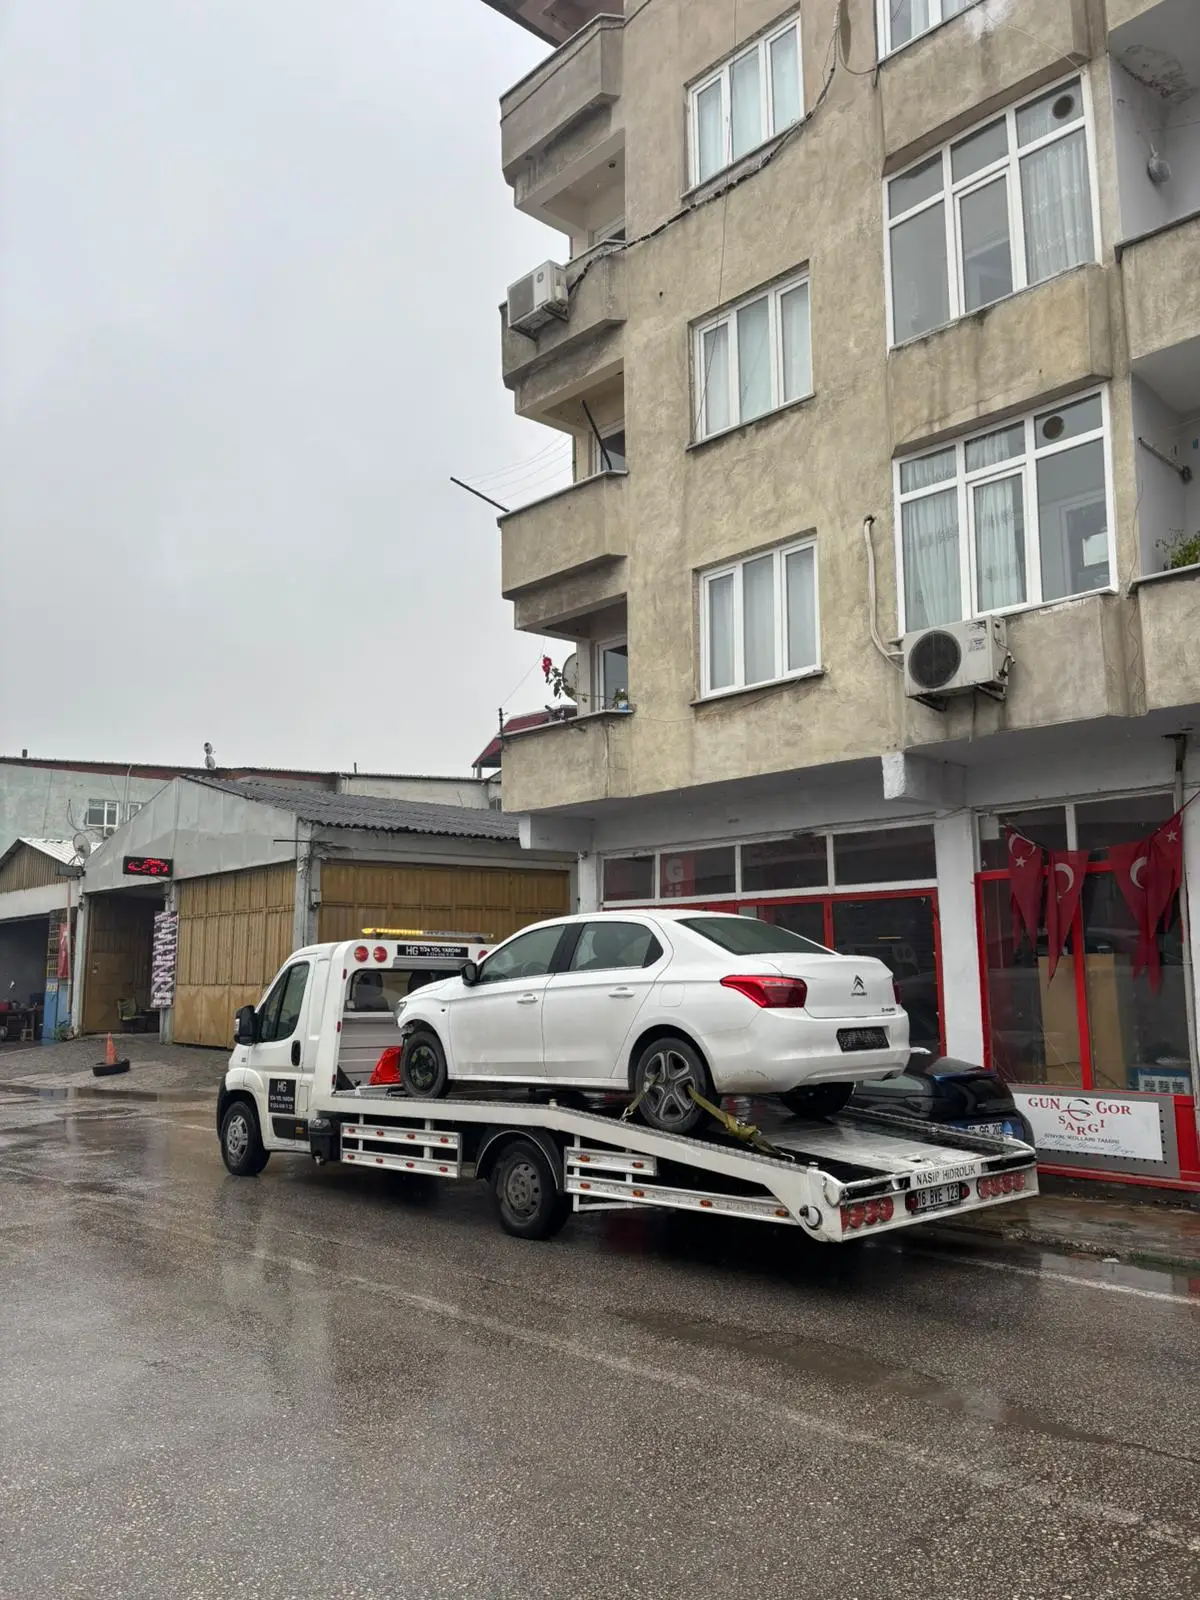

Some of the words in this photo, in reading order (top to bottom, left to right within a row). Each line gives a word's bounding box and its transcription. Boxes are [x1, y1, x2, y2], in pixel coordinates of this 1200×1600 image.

[406, 945, 419, 956] HG
[1058, 1115, 1105, 1136] SARGI
[917, 1191, 927, 1206] 16
[946, 1184, 959, 1200] 123
